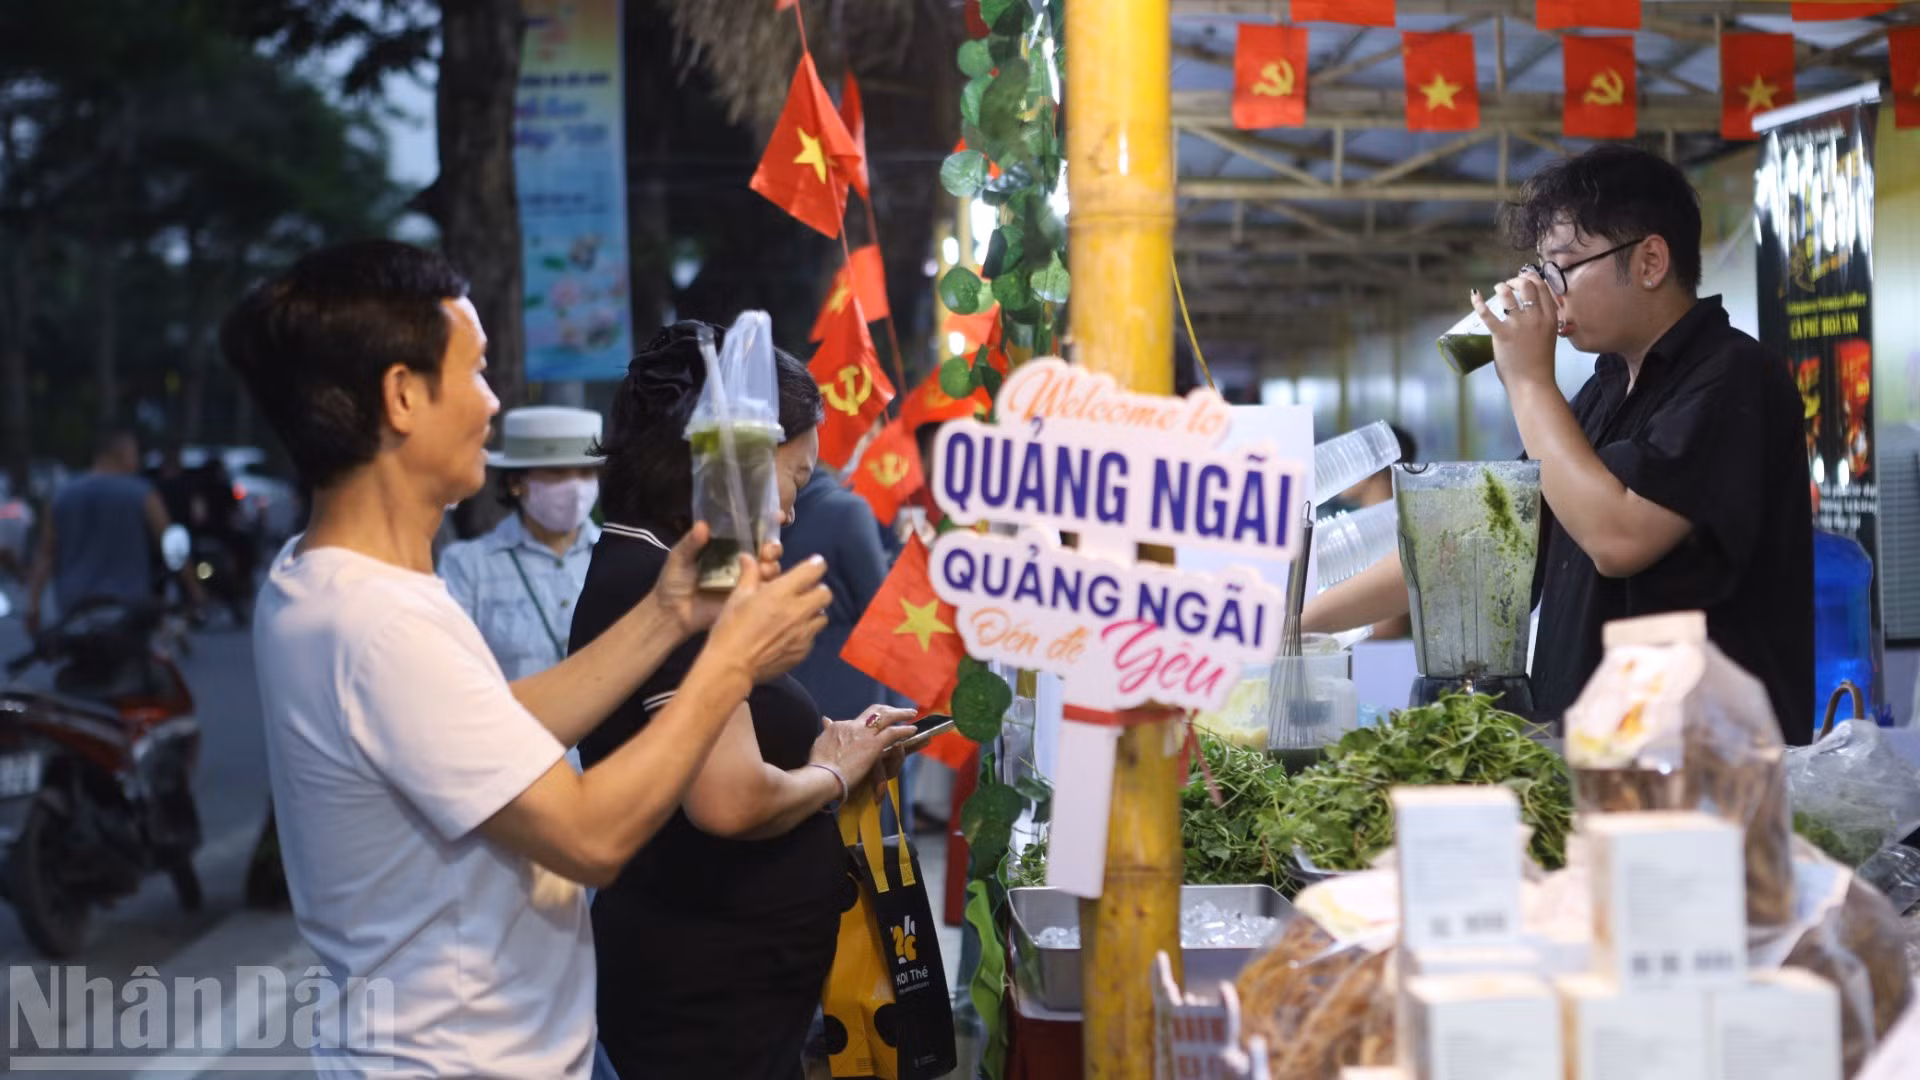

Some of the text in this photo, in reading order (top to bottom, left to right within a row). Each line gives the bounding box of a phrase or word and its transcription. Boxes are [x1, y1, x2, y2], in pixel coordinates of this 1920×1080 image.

[1008, 366, 1226, 436] Welcome to
[944, 417, 1292, 547] QUẢNG NGÃI
[943, 544, 1264, 648] QUẢNG NGÃI
[896, 965, 929, 986] KOI Thé
